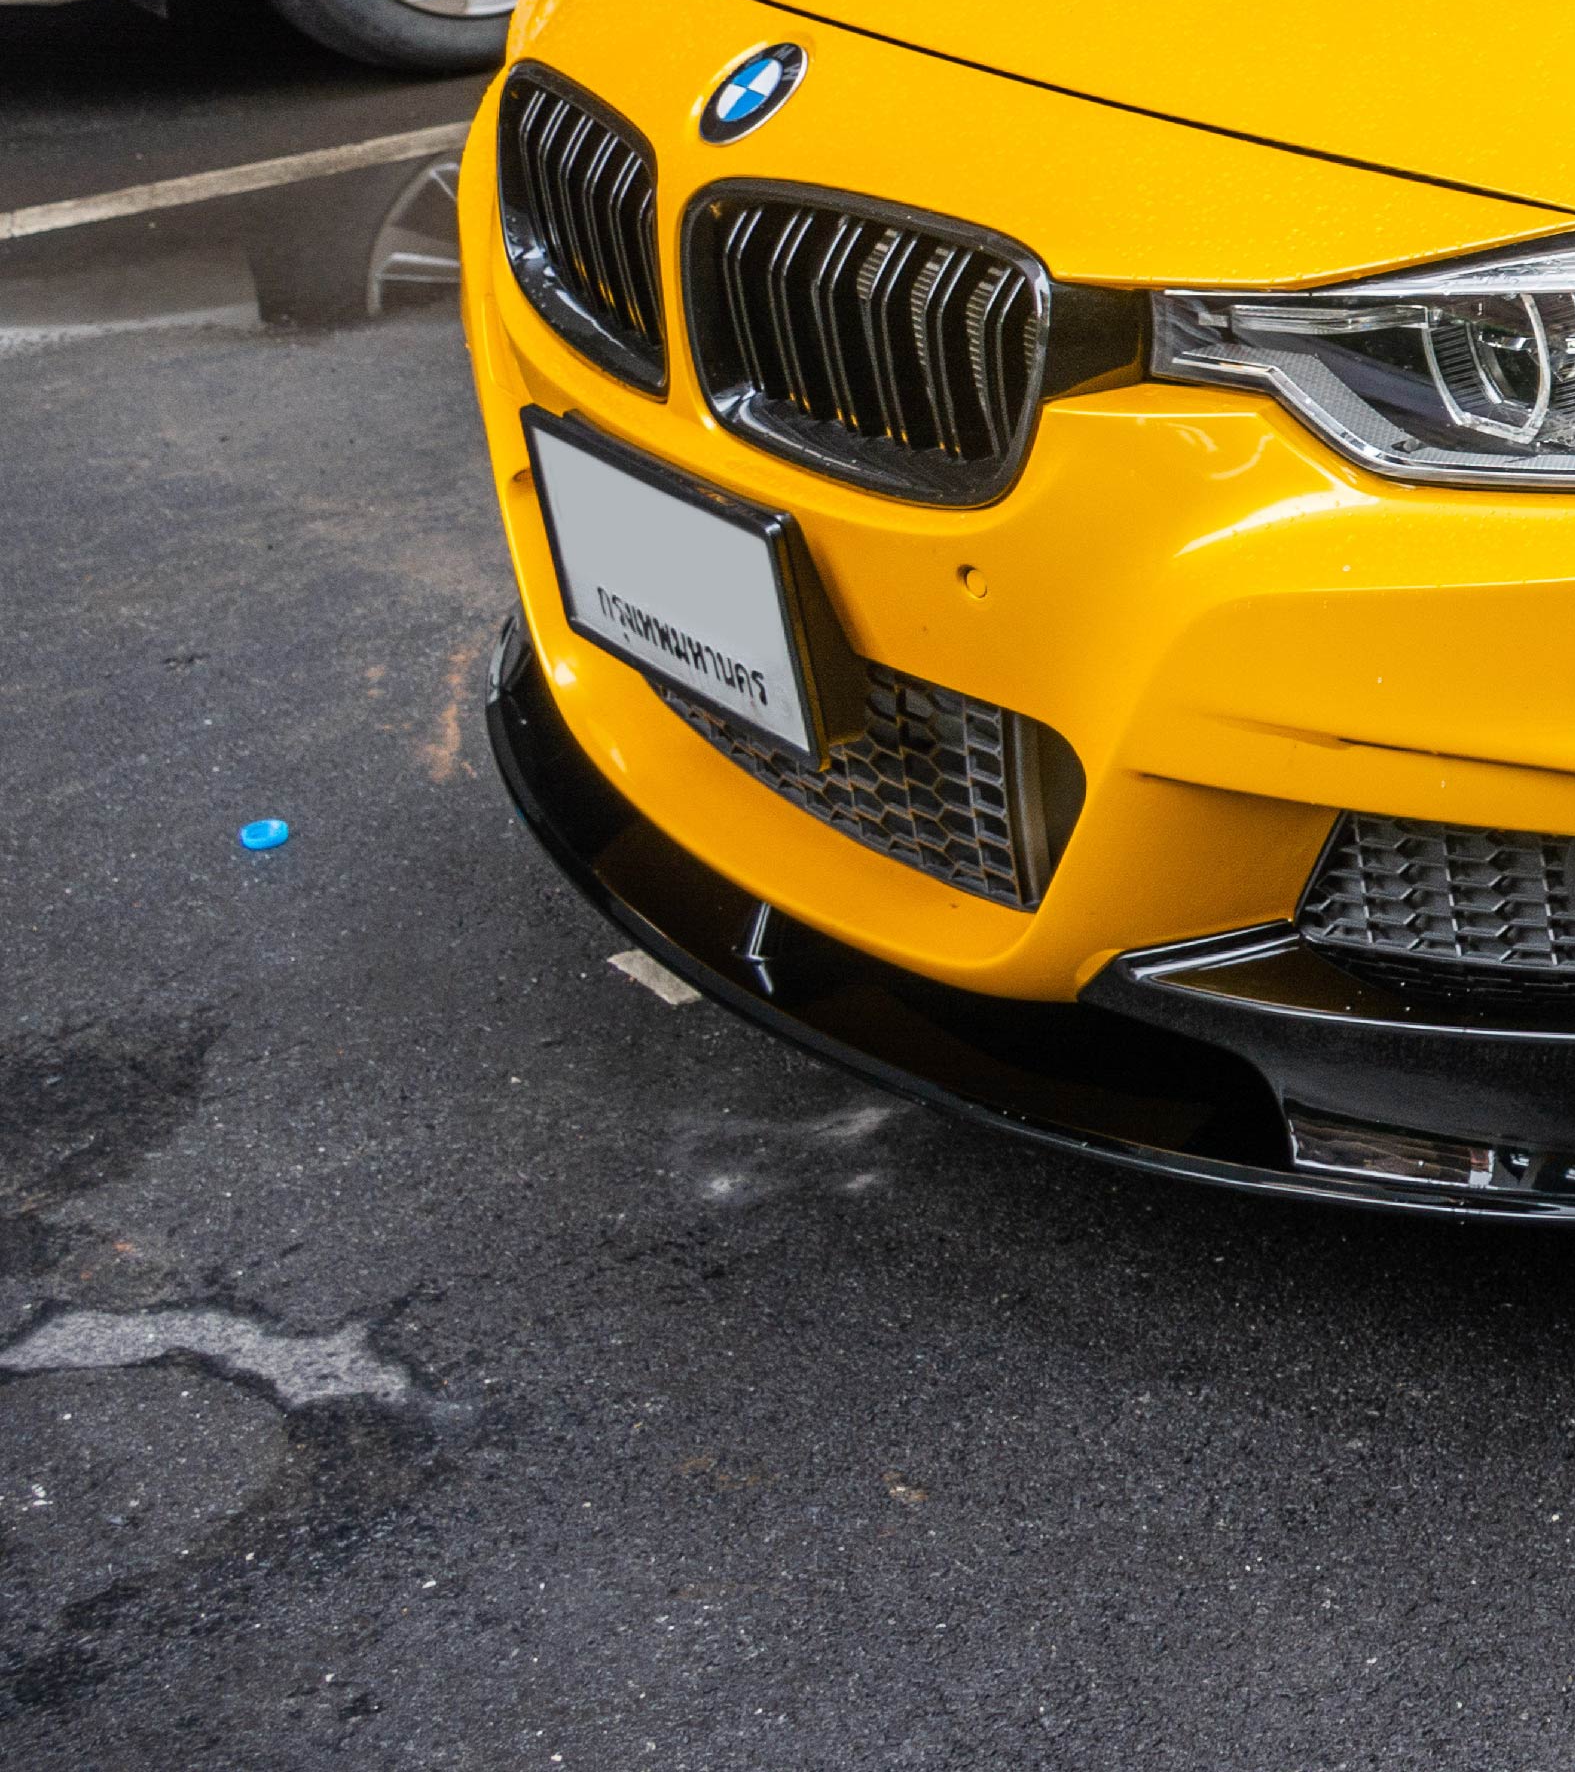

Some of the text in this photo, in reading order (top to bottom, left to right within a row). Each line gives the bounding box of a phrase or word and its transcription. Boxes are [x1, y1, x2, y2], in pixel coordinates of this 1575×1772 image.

[597, 586, 768, 706] กรุงเทพมหานคร
